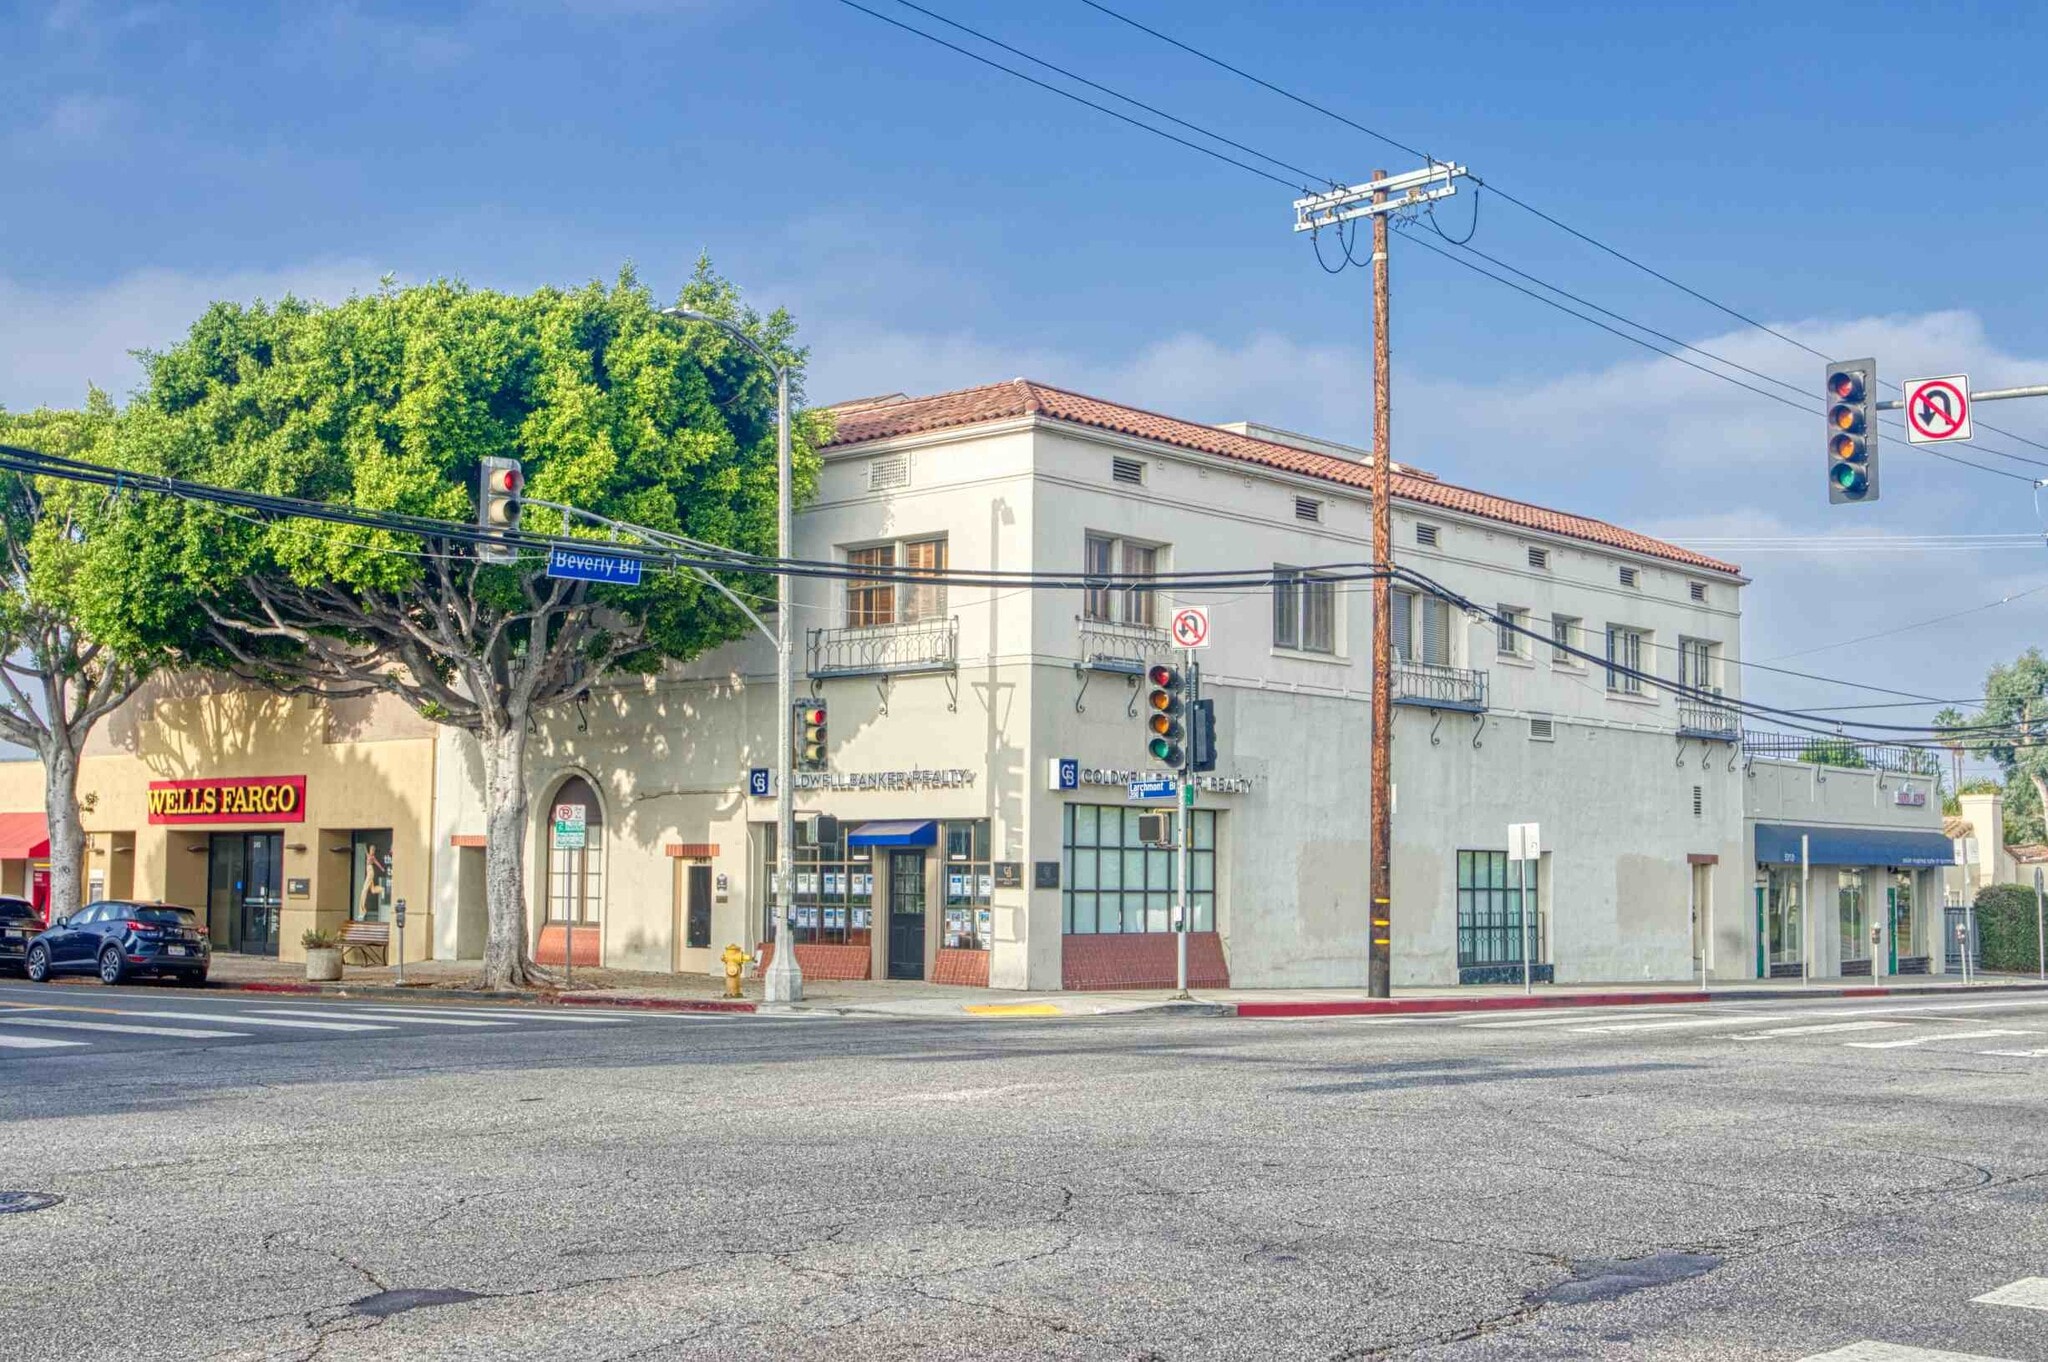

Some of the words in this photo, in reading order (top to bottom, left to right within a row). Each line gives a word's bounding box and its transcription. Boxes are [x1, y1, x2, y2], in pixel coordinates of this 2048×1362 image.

[556, 552, 614, 577] Beverly
[619, 558, 635, 575] Bl
[775, 772, 848, 789] LDWELL
[849, 771, 905, 787] BANKER
[912, 768, 970, 785] REALTY
[1130, 781, 1164, 792] Larchmont
[1210, 776, 1253, 793] REALTY
[147, 786, 217, 815] WELLS
[220, 784, 296, 813] FARGO
